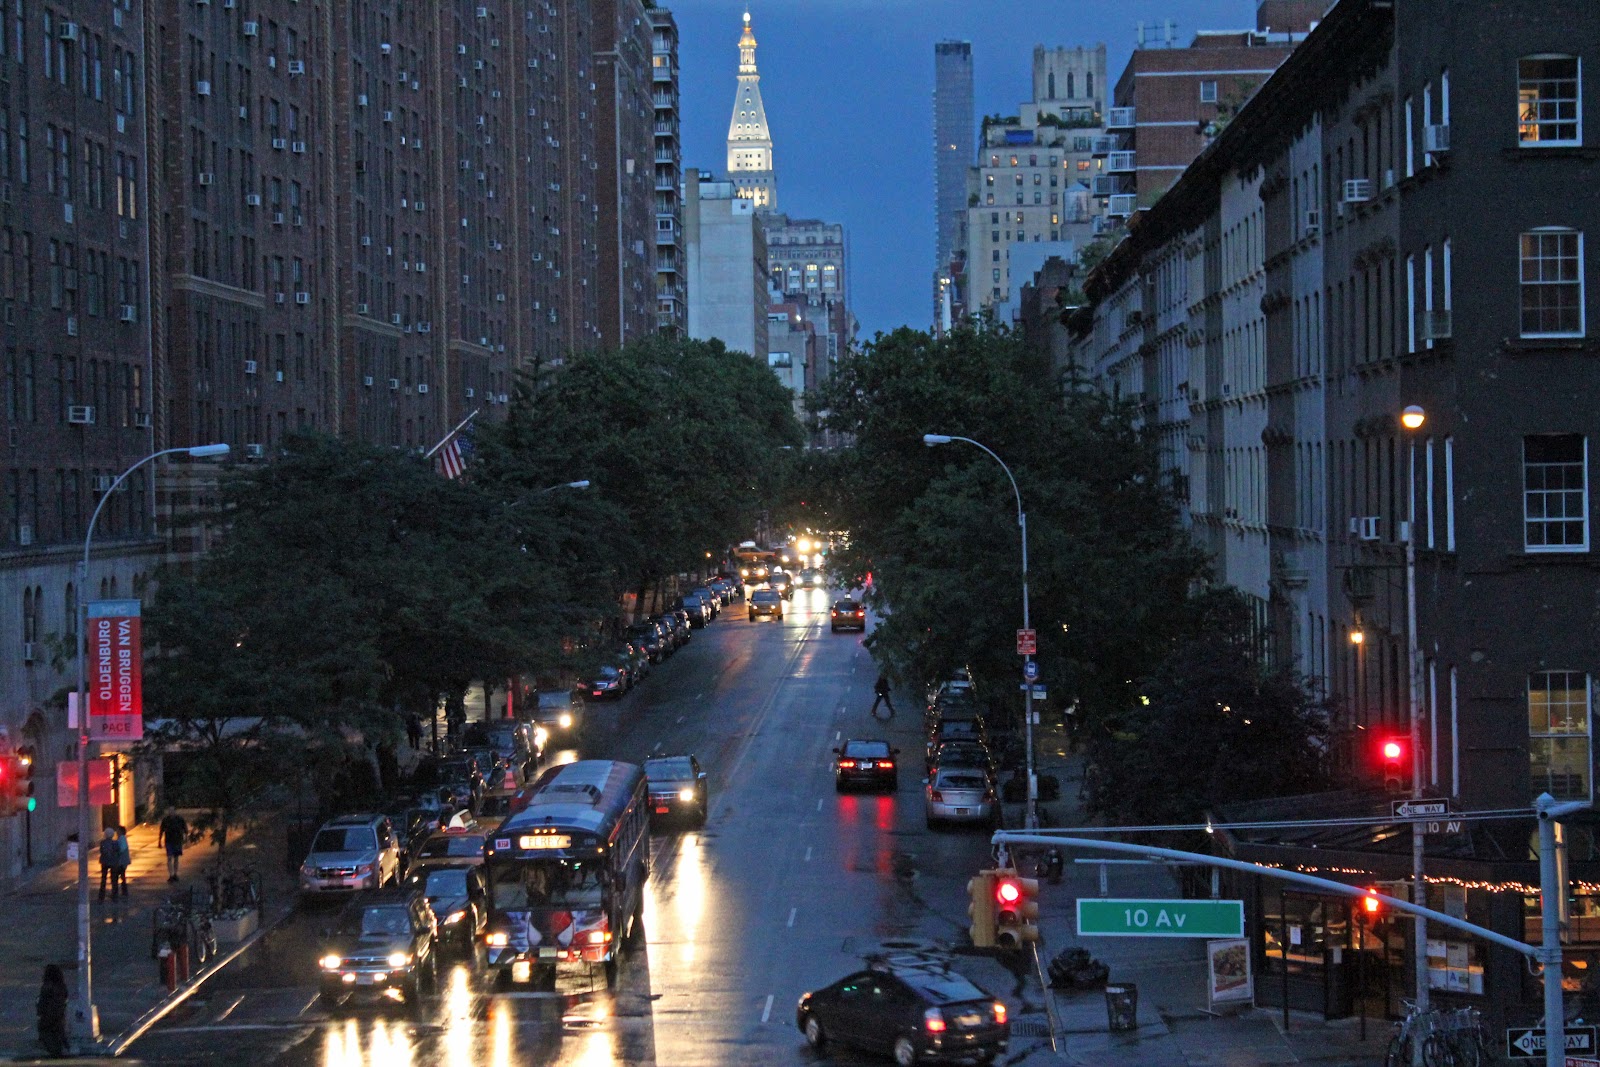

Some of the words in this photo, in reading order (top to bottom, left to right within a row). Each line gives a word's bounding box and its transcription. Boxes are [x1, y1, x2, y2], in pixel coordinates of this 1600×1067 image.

[118, 619, 131, 646] VAN
[98, 620, 112, 700] OLDENBURG
[118, 649, 132, 712] BRUGGEN
[102, 723, 131, 732] PACE
[1401, 806, 1417, 814] ONE
[1424, 805, 1441, 813] WAY
[1428, 822, 1439, 833] 10
[1446, 821, 1461, 833] AV
[1124, 909, 1149, 927] 10
[1522, 1037, 1546, 1049] ONE
[1564, 1036, 1584, 1048] AY
